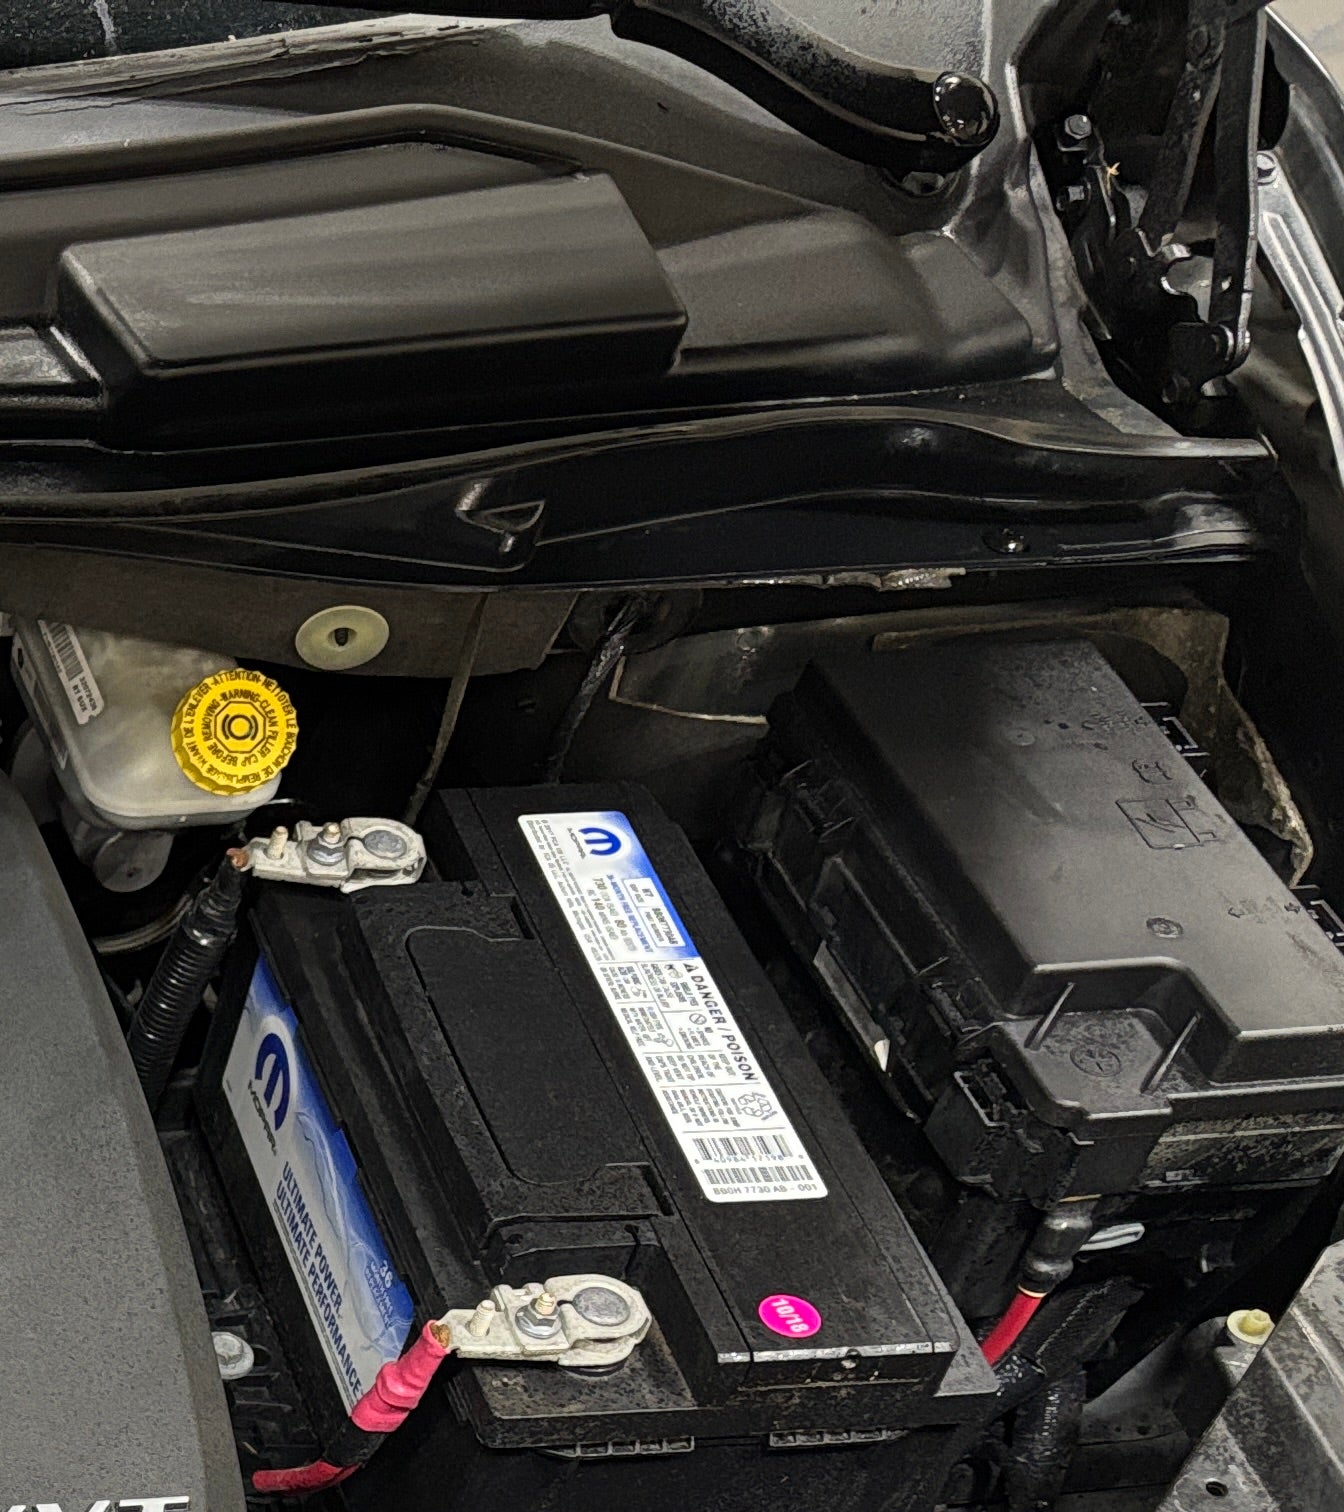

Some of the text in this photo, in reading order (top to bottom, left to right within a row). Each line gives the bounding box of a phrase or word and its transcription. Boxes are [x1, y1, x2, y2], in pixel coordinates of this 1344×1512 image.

[689, 975, 727, 1024] DANGER
[720, 1034, 758, 1080] POISON
[275, 1178, 311, 1270] ULTIMATE
[281, 1157, 318, 1251] ULTIMATE
[771, 1298, 810, 1333] 10/18
